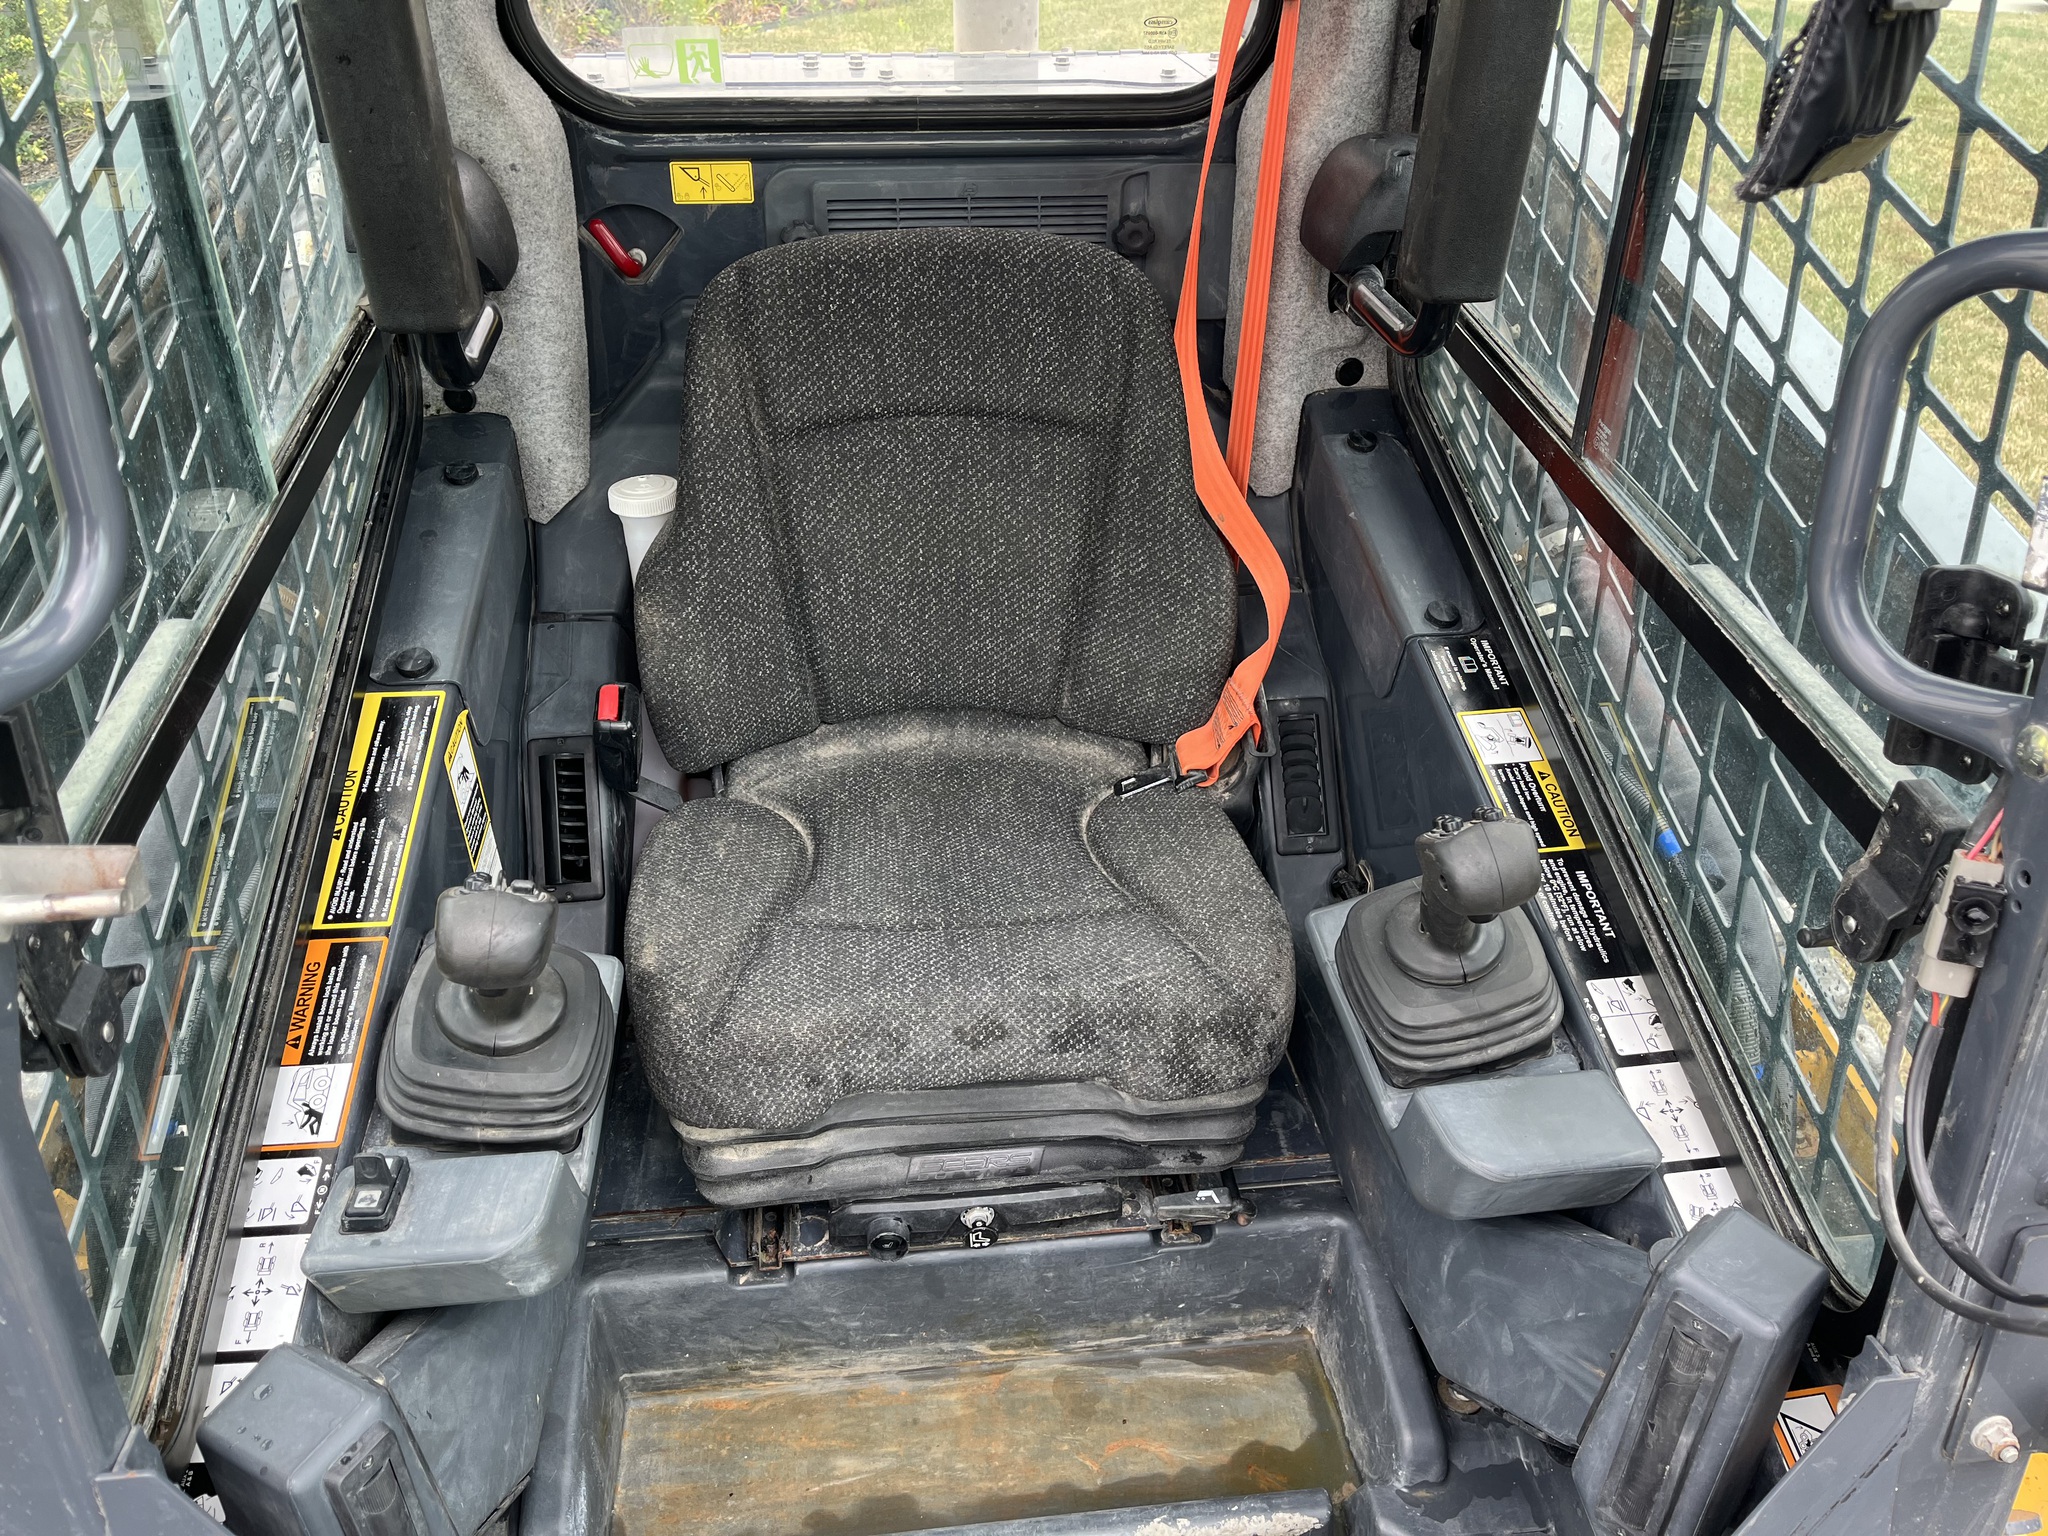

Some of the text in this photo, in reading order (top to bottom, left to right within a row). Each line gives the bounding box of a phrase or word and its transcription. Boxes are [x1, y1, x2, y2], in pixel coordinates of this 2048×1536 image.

[1470, 637, 1500, 690] Operator's Manual
[1481, 640, 1509, 685] IMPORTANT
[373, 732, 382, 748] others
[366, 756, 376, 775] children
[374, 773, 384, 787] Never
[379, 761, 388, 774] carry
[362, 775, 372, 789] Keep
[1518, 762, 1547, 812] Avoid Overturn
[336, 770, 358, 825] CAUTION
[1504, 767, 1547, 848] Avoid steep slopes and high speed
[1545, 783, 1581, 837] CAUTION
[336, 817, 367, 914] Operator's Manual before operating this
[368, 844, 379, 866] function
[394, 844, 404, 866] windows
[329, 821, 359, 914] AVOID INJURY Read and understand
[366, 866, 374, 876] and
[377, 862, 387, 882] devices
[1539, 859, 1553, 879] below
[360, 876, 371, 898] location
[374, 882, 383, 899] safety
[386, 877, 396, 898] screens
[1543, 883, 1552, 892] 10
[345, 890, 355, 914] machine.
[356, 897, 366, 913] Know
[369, 898, 379, 913] Keep
[382, 897, 392, 912] Keep
[1537, 891, 1558, 930] of controls.
[1546, 892, 1563, 919] minutes
[1547, 858, 1594, 948] and engine, in temperatures
[1556, 857, 1609, 963] To prevent damage of hydraulics
[1576, 870, 1616, 937] IMPORTANT
[1559, 919, 1573, 942] before
[1565, 914, 1575, 927] run
[1571, 927, 1580, 935] at
[1574, 935, 1587, 952] slow
[290, 962, 321, 1032] WARNING
[317, 945, 350, 1056] working on or around this machine with
[337, 954, 368, 1055] See Operator's Manual for complete
[307, 966, 337, 1057] Always install boom lock before
[324, 988, 347, 1056] the loader boom raised.
